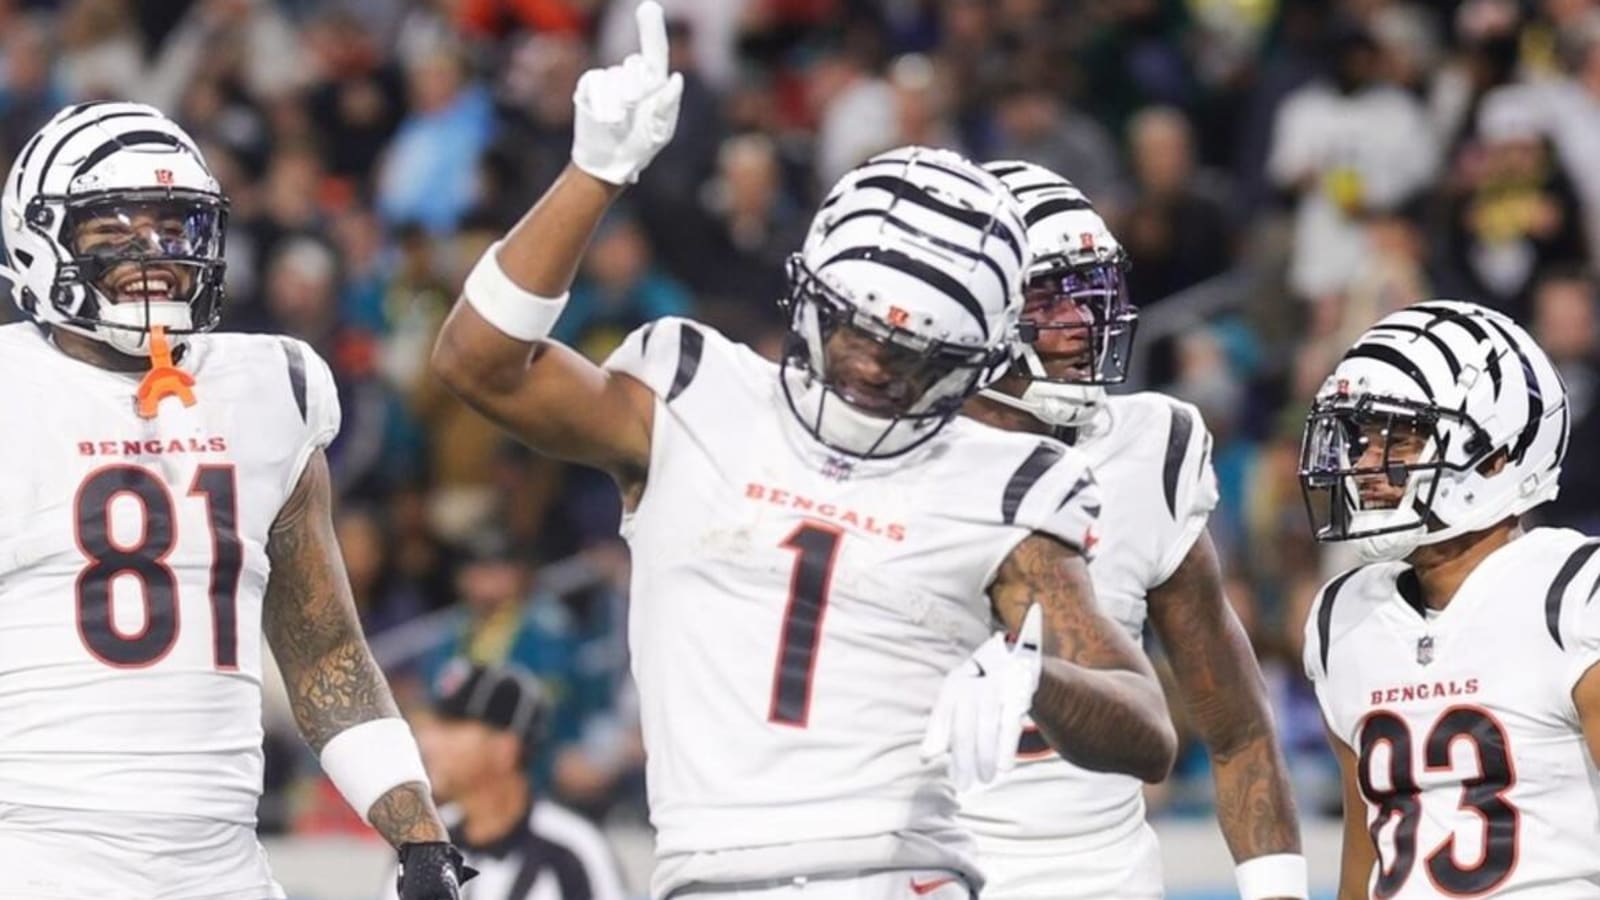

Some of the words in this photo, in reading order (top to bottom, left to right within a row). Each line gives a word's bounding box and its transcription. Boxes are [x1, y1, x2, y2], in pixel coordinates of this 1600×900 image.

[77, 437, 227, 456] BENGALS
[73, 463, 243, 671] 81
[744, 482, 907, 542] BENGALS
[766, 516, 845, 729] 1
[1371, 678, 1480, 705] BENGALS
[1357, 704, 1521, 900] 83
